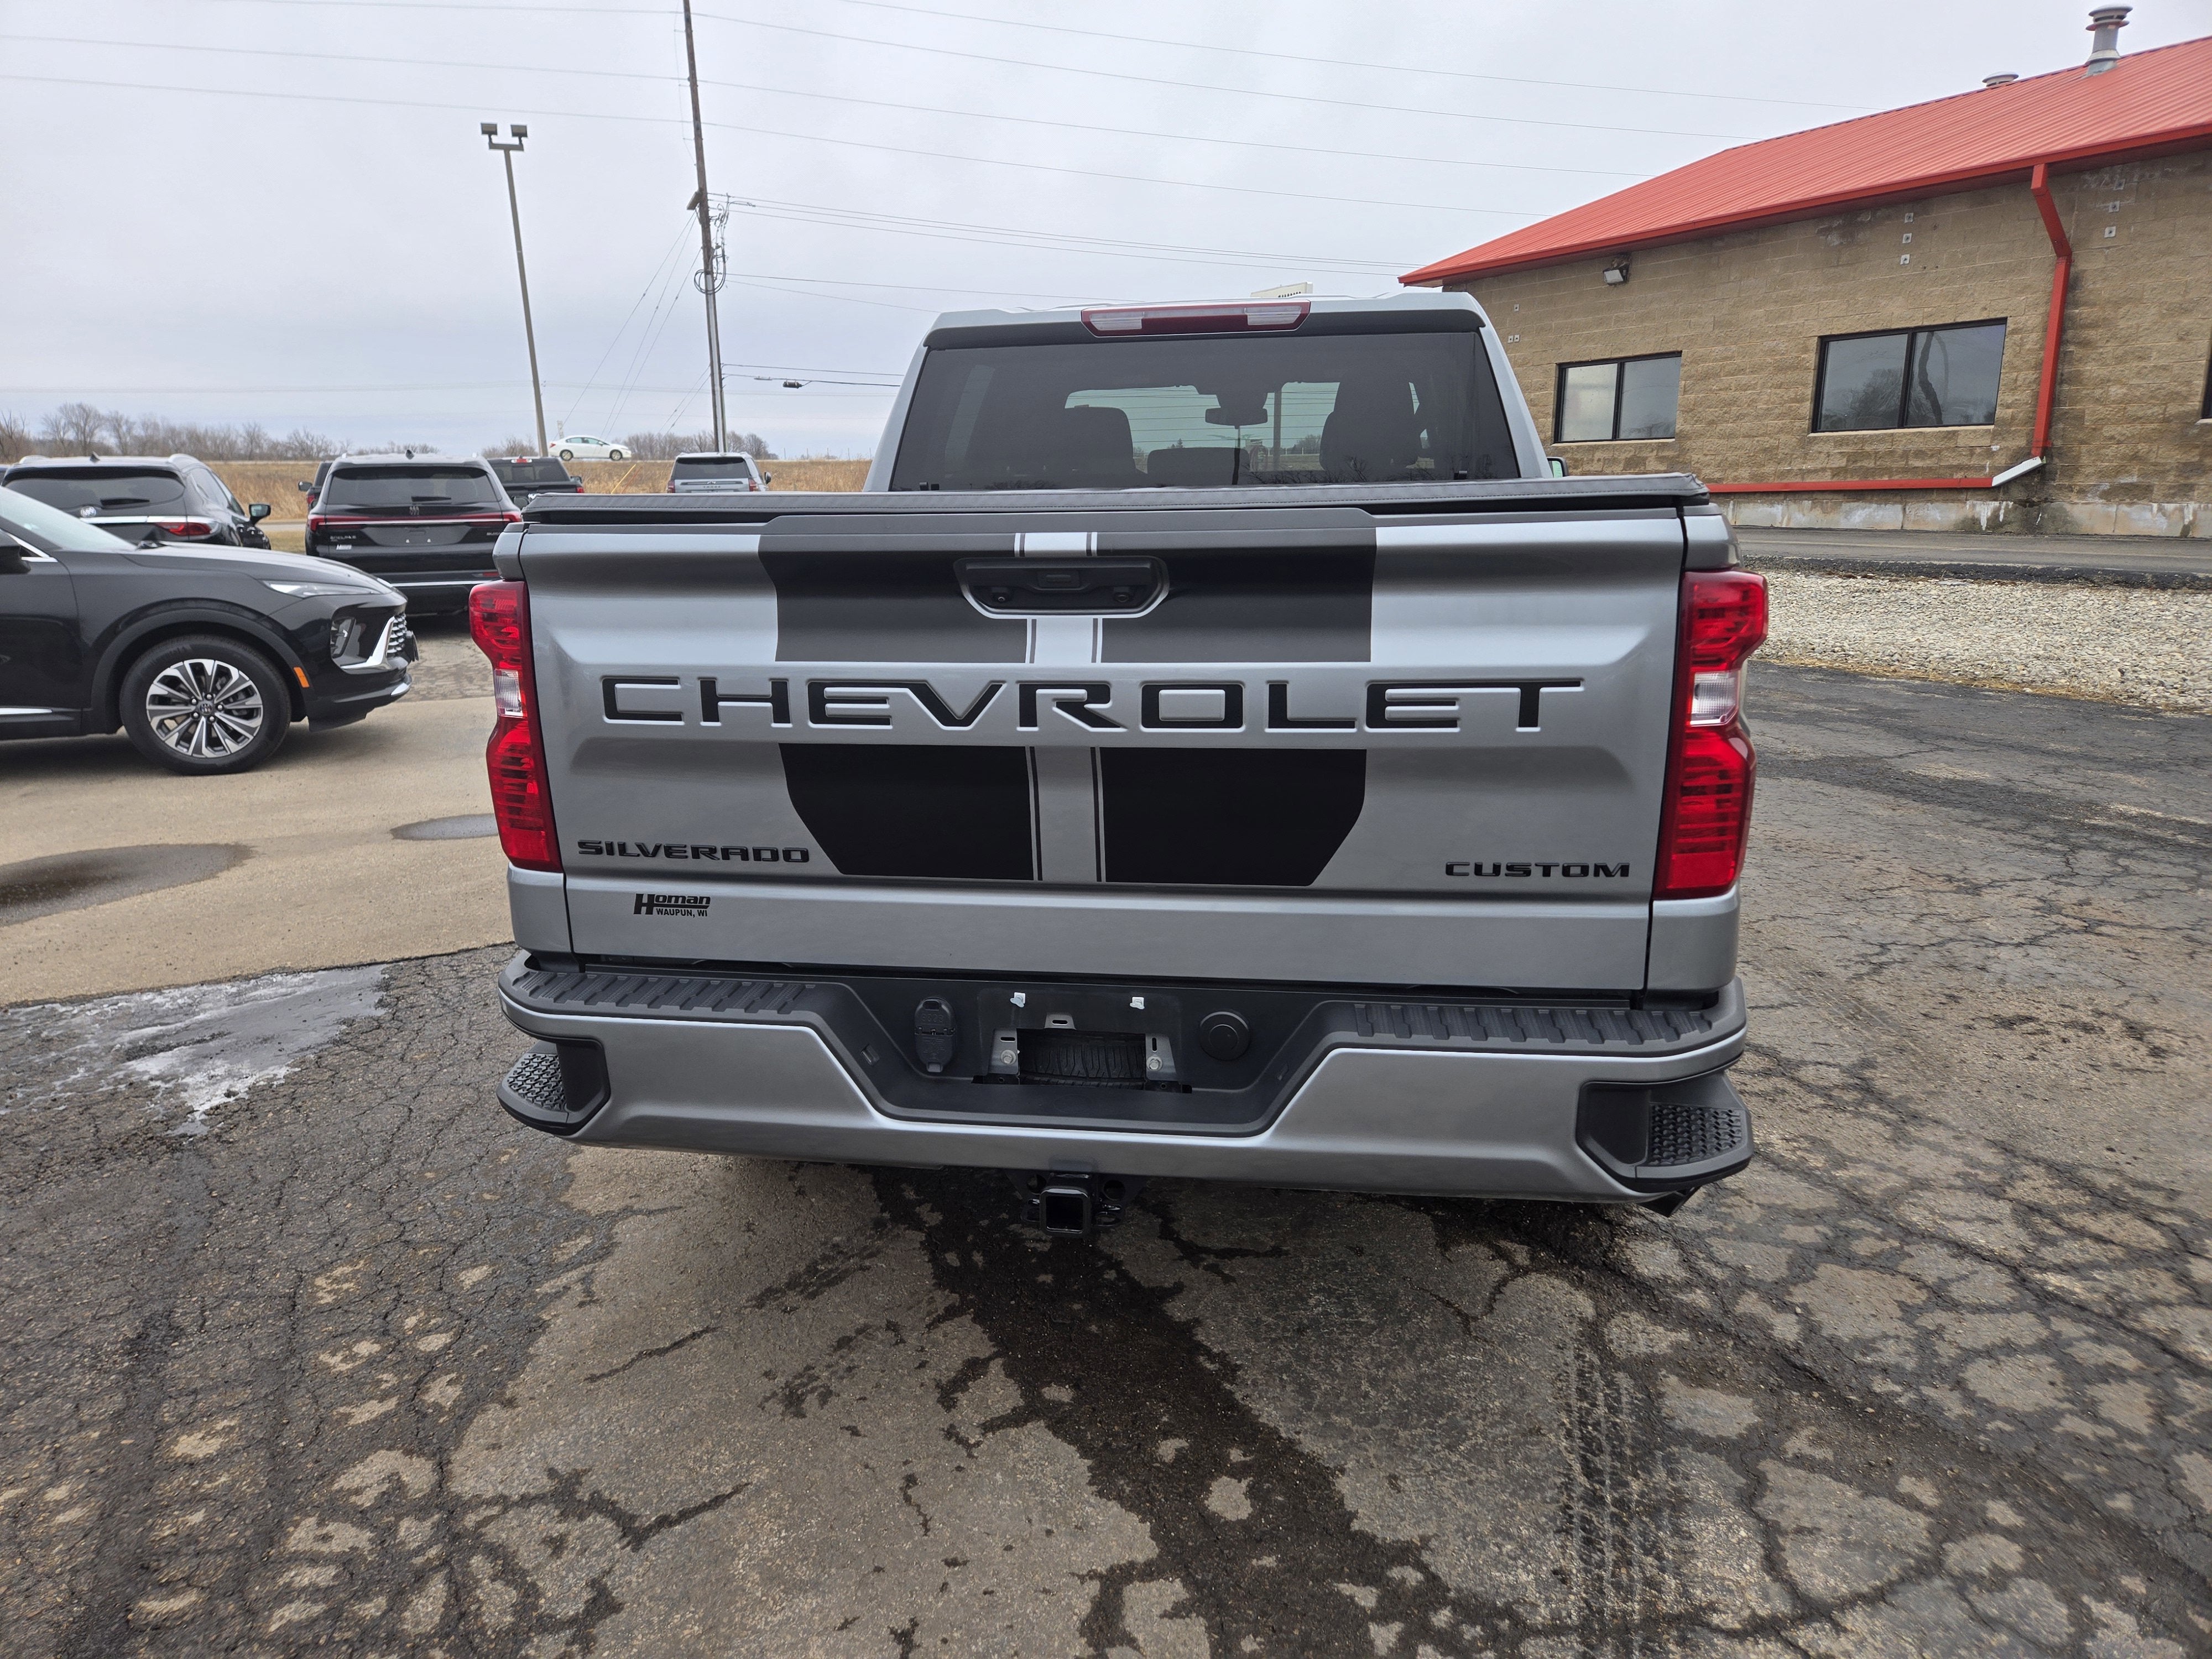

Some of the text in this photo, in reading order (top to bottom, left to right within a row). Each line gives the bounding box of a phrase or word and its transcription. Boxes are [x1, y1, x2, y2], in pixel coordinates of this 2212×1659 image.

[602, 676, 1584, 732] CHEVROLET
[577, 839, 810, 863] SILVERADO
[1446, 862, 1630, 877] CUSTOM
[633, 893, 711, 915] Homan
[656, 908, 695, 917] WAUPUN,
